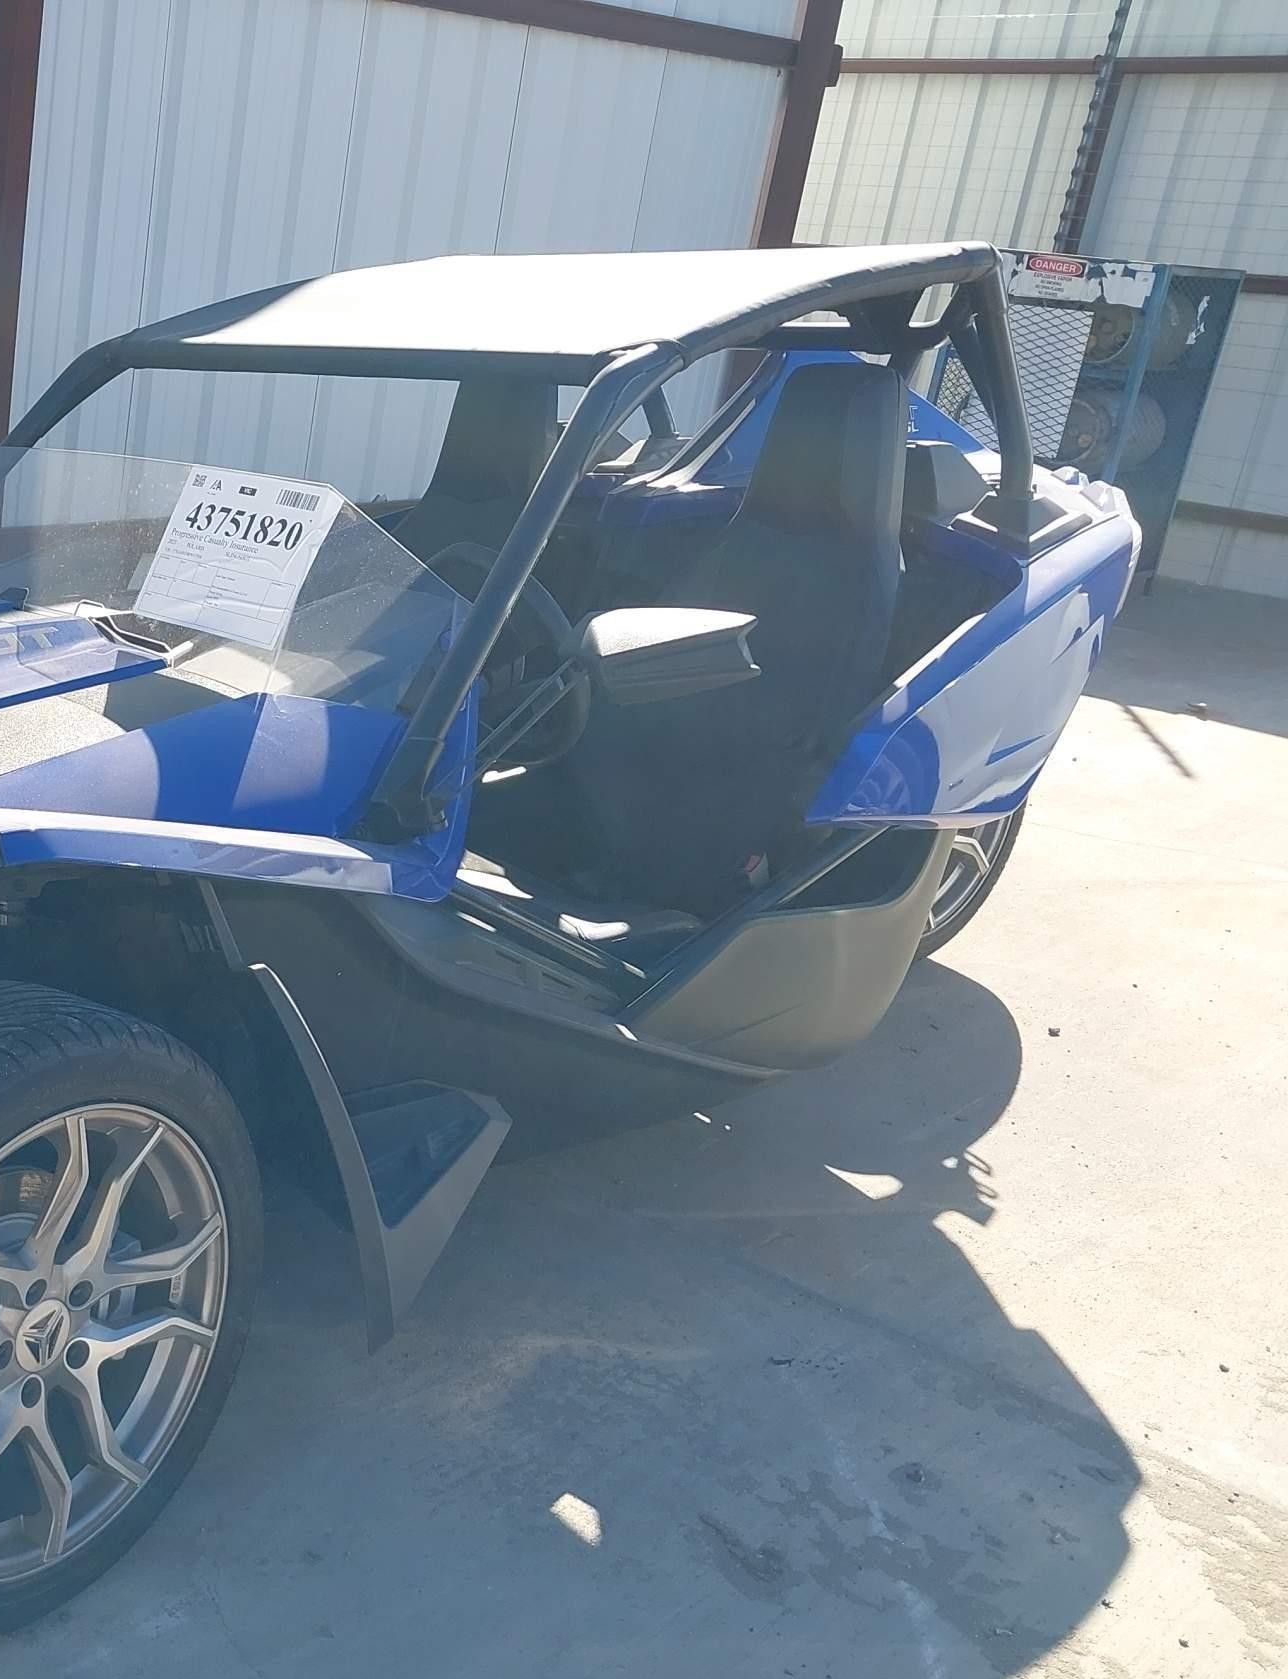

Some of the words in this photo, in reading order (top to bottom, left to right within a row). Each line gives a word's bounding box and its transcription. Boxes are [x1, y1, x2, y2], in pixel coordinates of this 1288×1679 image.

[1035, 260, 1077, 273] DANGER
[185, 501, 304, 551] 43751820
[171, 527, 205, 542] Progressive
[204, 534, 228, 549] Casualty
[229, 540, 259, 554] Insurance
